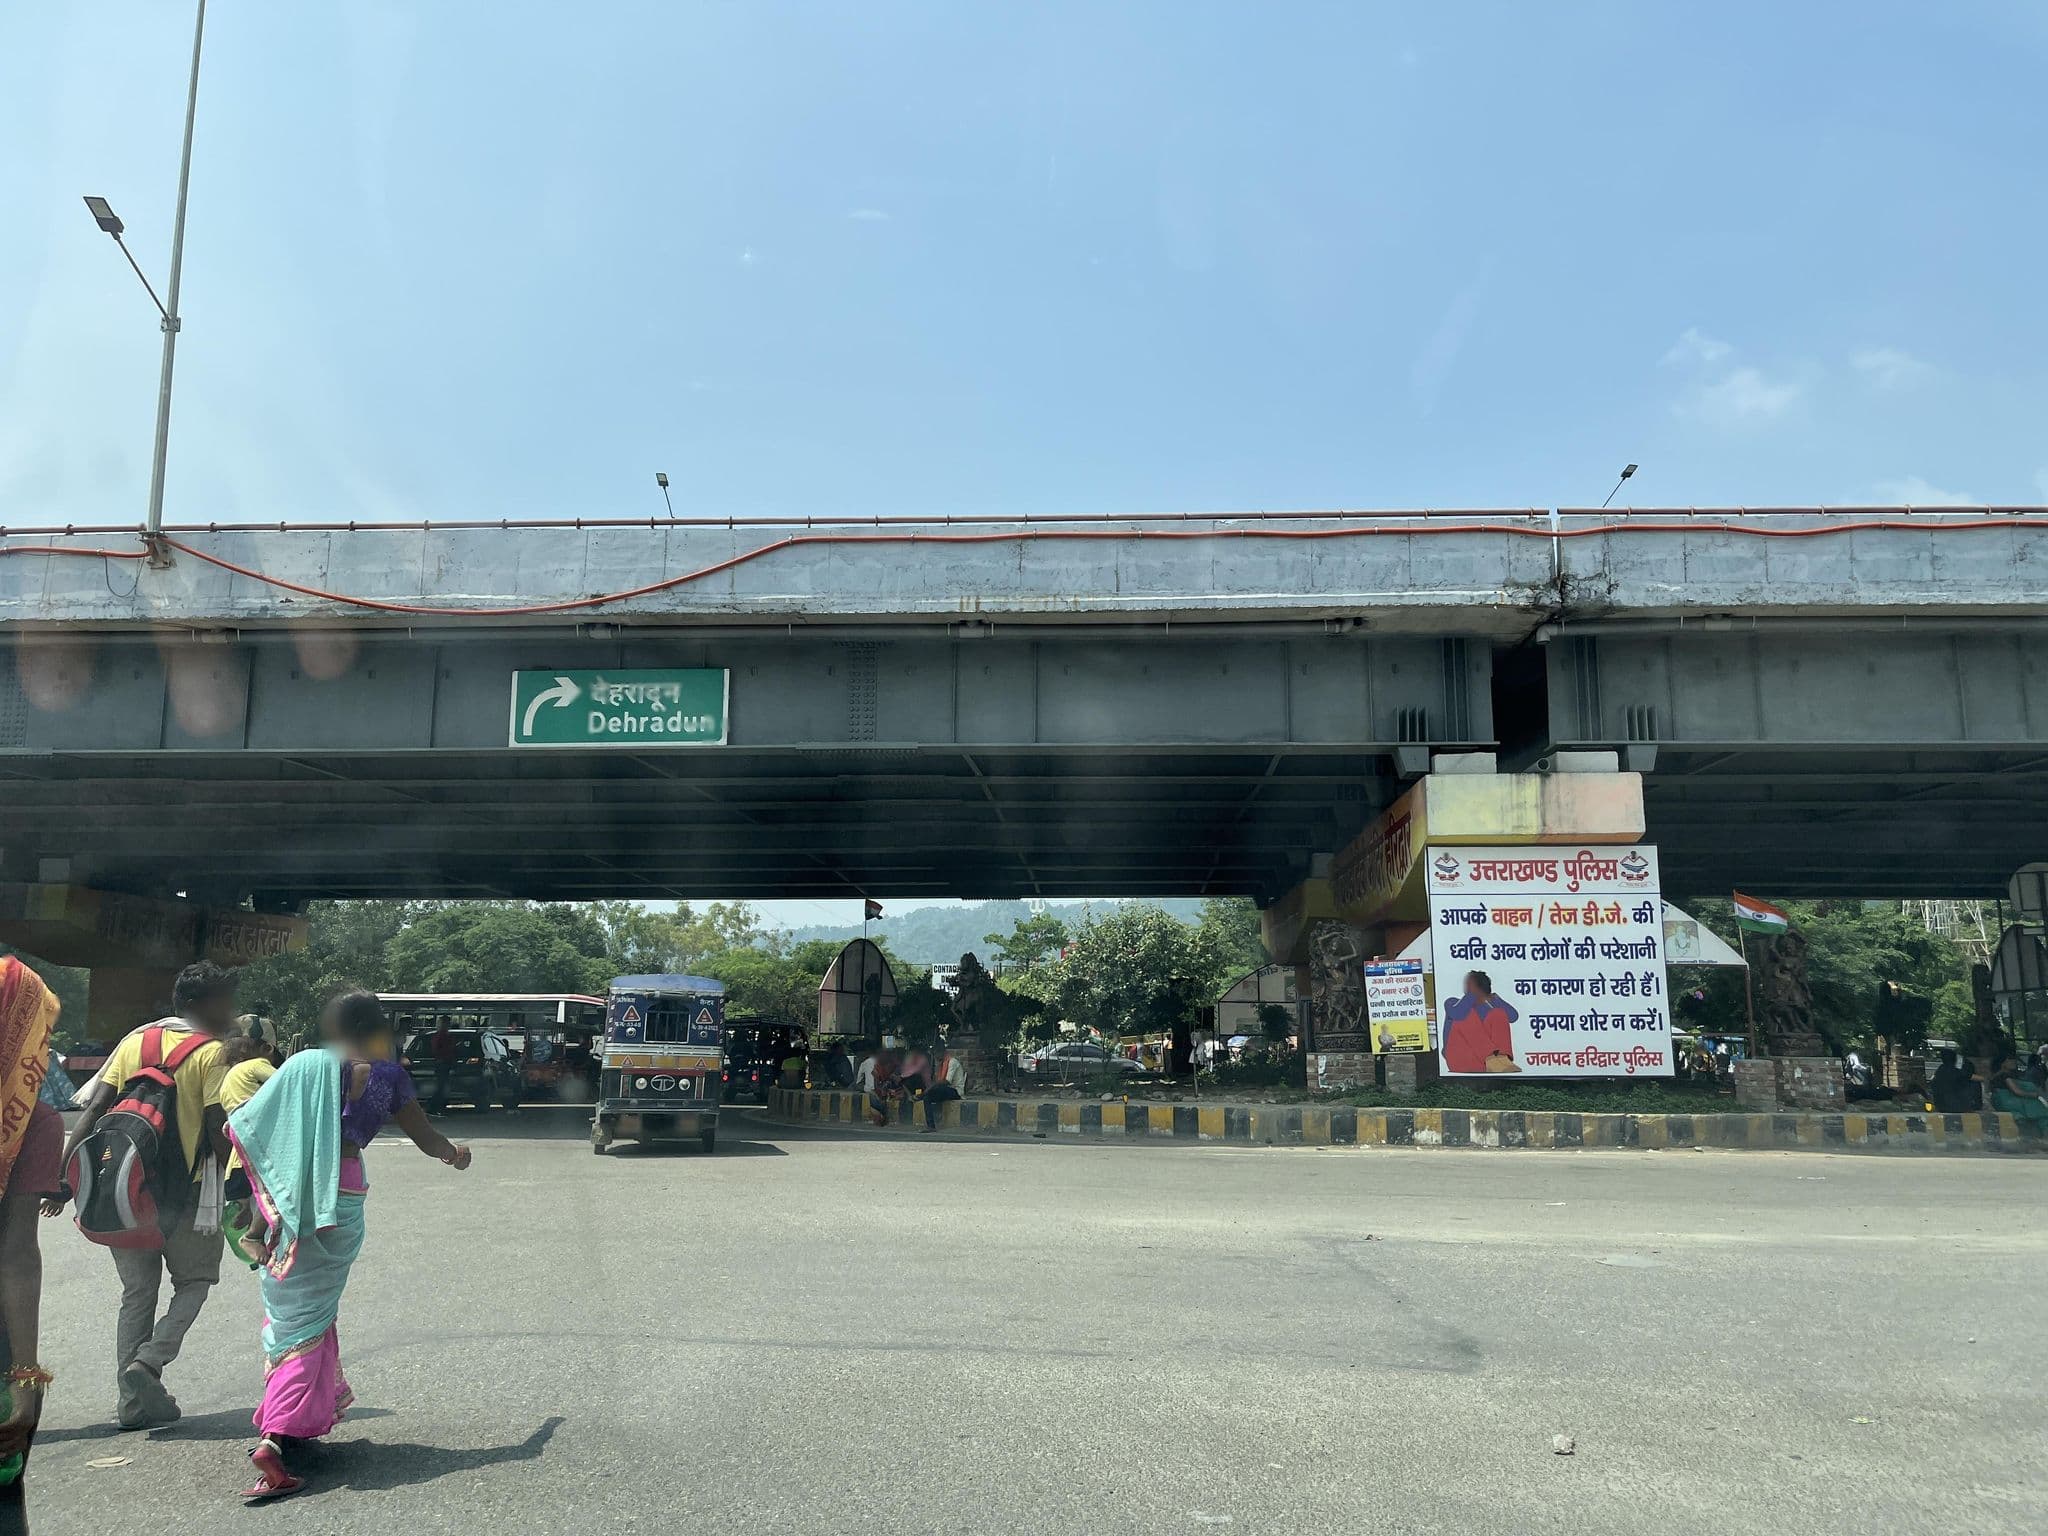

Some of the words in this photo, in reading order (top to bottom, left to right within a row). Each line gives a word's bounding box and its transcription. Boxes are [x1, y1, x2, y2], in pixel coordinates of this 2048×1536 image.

[590, 677, 682, 711] देहरादून
[588, 711, 715, 733] Dehradun
[1468, 859, 1559, 882] उत्तराखण्ड
[1563, 850, 1619, 892] पुलिस
[1439, 902, 1487, 925] आपके
[1491, 908, 1533, 927] वाहन
[1549, 902, 1578, 925] तेज
[1582, 900, 1628, 926] डी.जे.
[1632, 900, 1654, 924] की
[1450, 936, 1487, 960] ध्वनि
[1491, 943, 1527, 961] अन्य
[1530, 936, 1571, 961] लोगों
[1574, 936, 1597, 960] की
[1601, 936, 1657, 961] परेशानी
[934, 965, 959, 973] CONTAC
[1514, 978, 1537, 996] का
[1540, 978, 1585, 996] कारण
[1589, 972, 1607, 997] हो
[1610, 971, 1636, 997] रही
[1529, 1014, 1576, 1039] कृपया
[1579, 1008, 1608, 1031] शोर
[1611, 1014, 1626, 1031] न
[1525, 1051, 1572, 1067] जनपद
[1575, 1046, 1620, 1067] हरिद्वार
[1623, 1046, 1663, 1074] पुलिस
